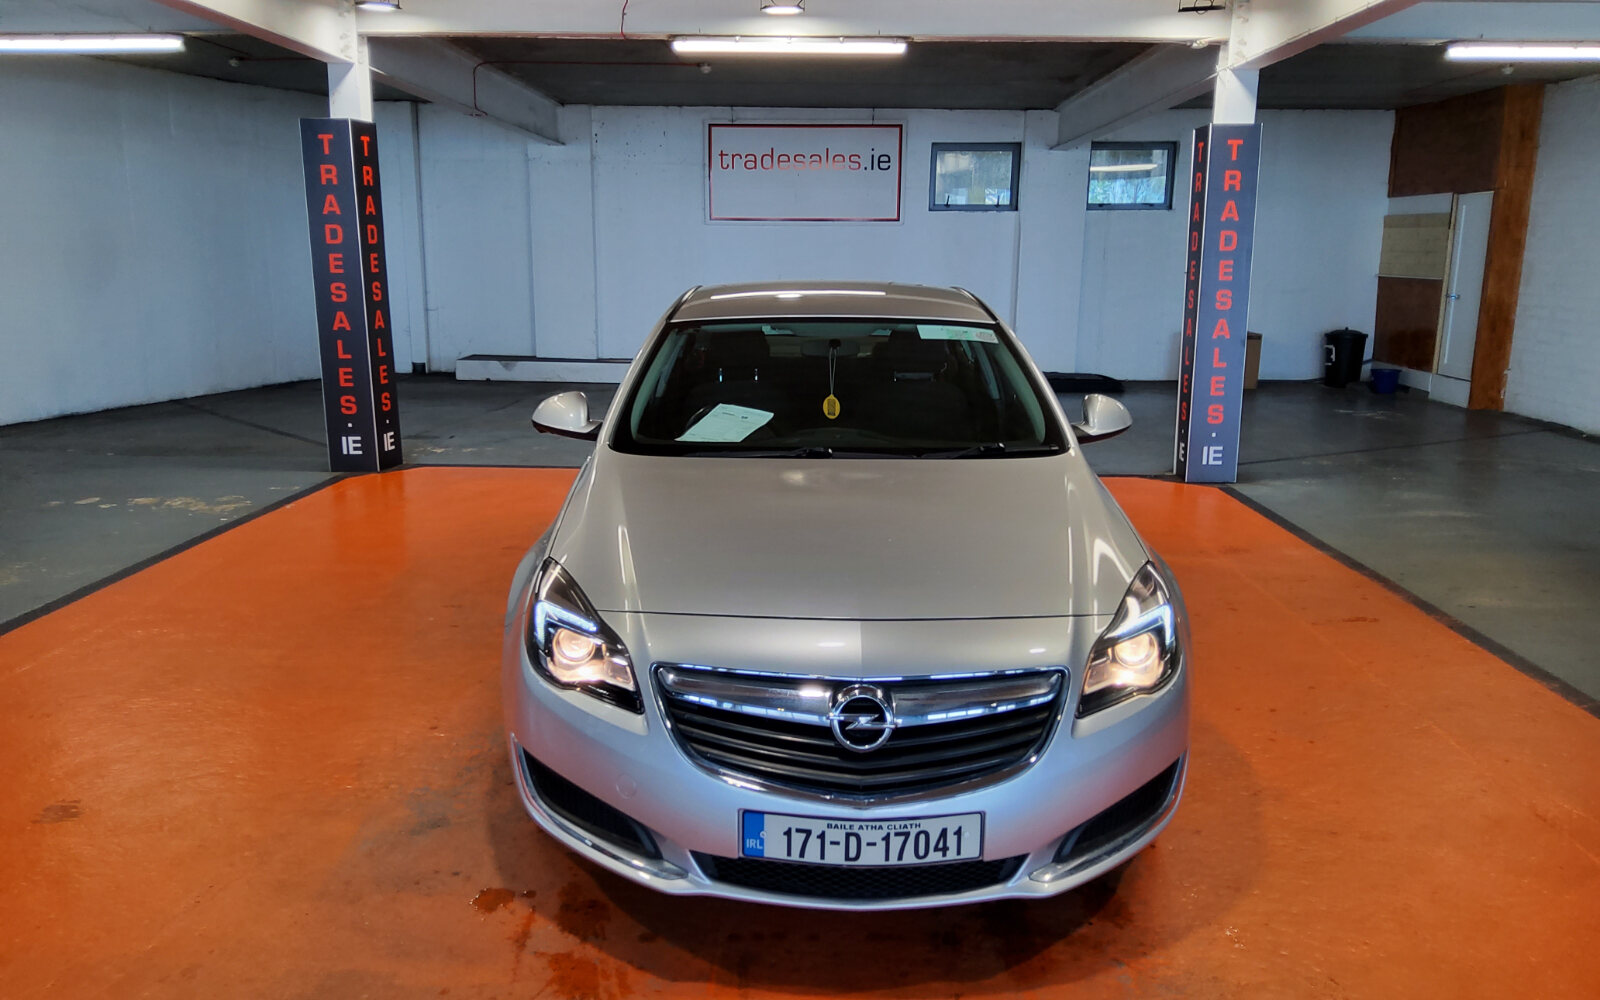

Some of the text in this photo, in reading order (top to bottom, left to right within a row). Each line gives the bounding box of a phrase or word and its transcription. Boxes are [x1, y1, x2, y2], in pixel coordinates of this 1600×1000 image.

[718, 147, 892, 171] tradesales.ie
[317, 134, 363, 455] TRADESALES.IE
[360, 136, 396, 452] TRADESALES.IE
[1201, 139, 1244, 465] TRADESALES.IE
[746, 838, 764, 850] IRL
[782, 825, 963, 862] 171-D-17041
[827, 823, 855, 831] BAILE
[886, 822, 921, 831] CLIATH
